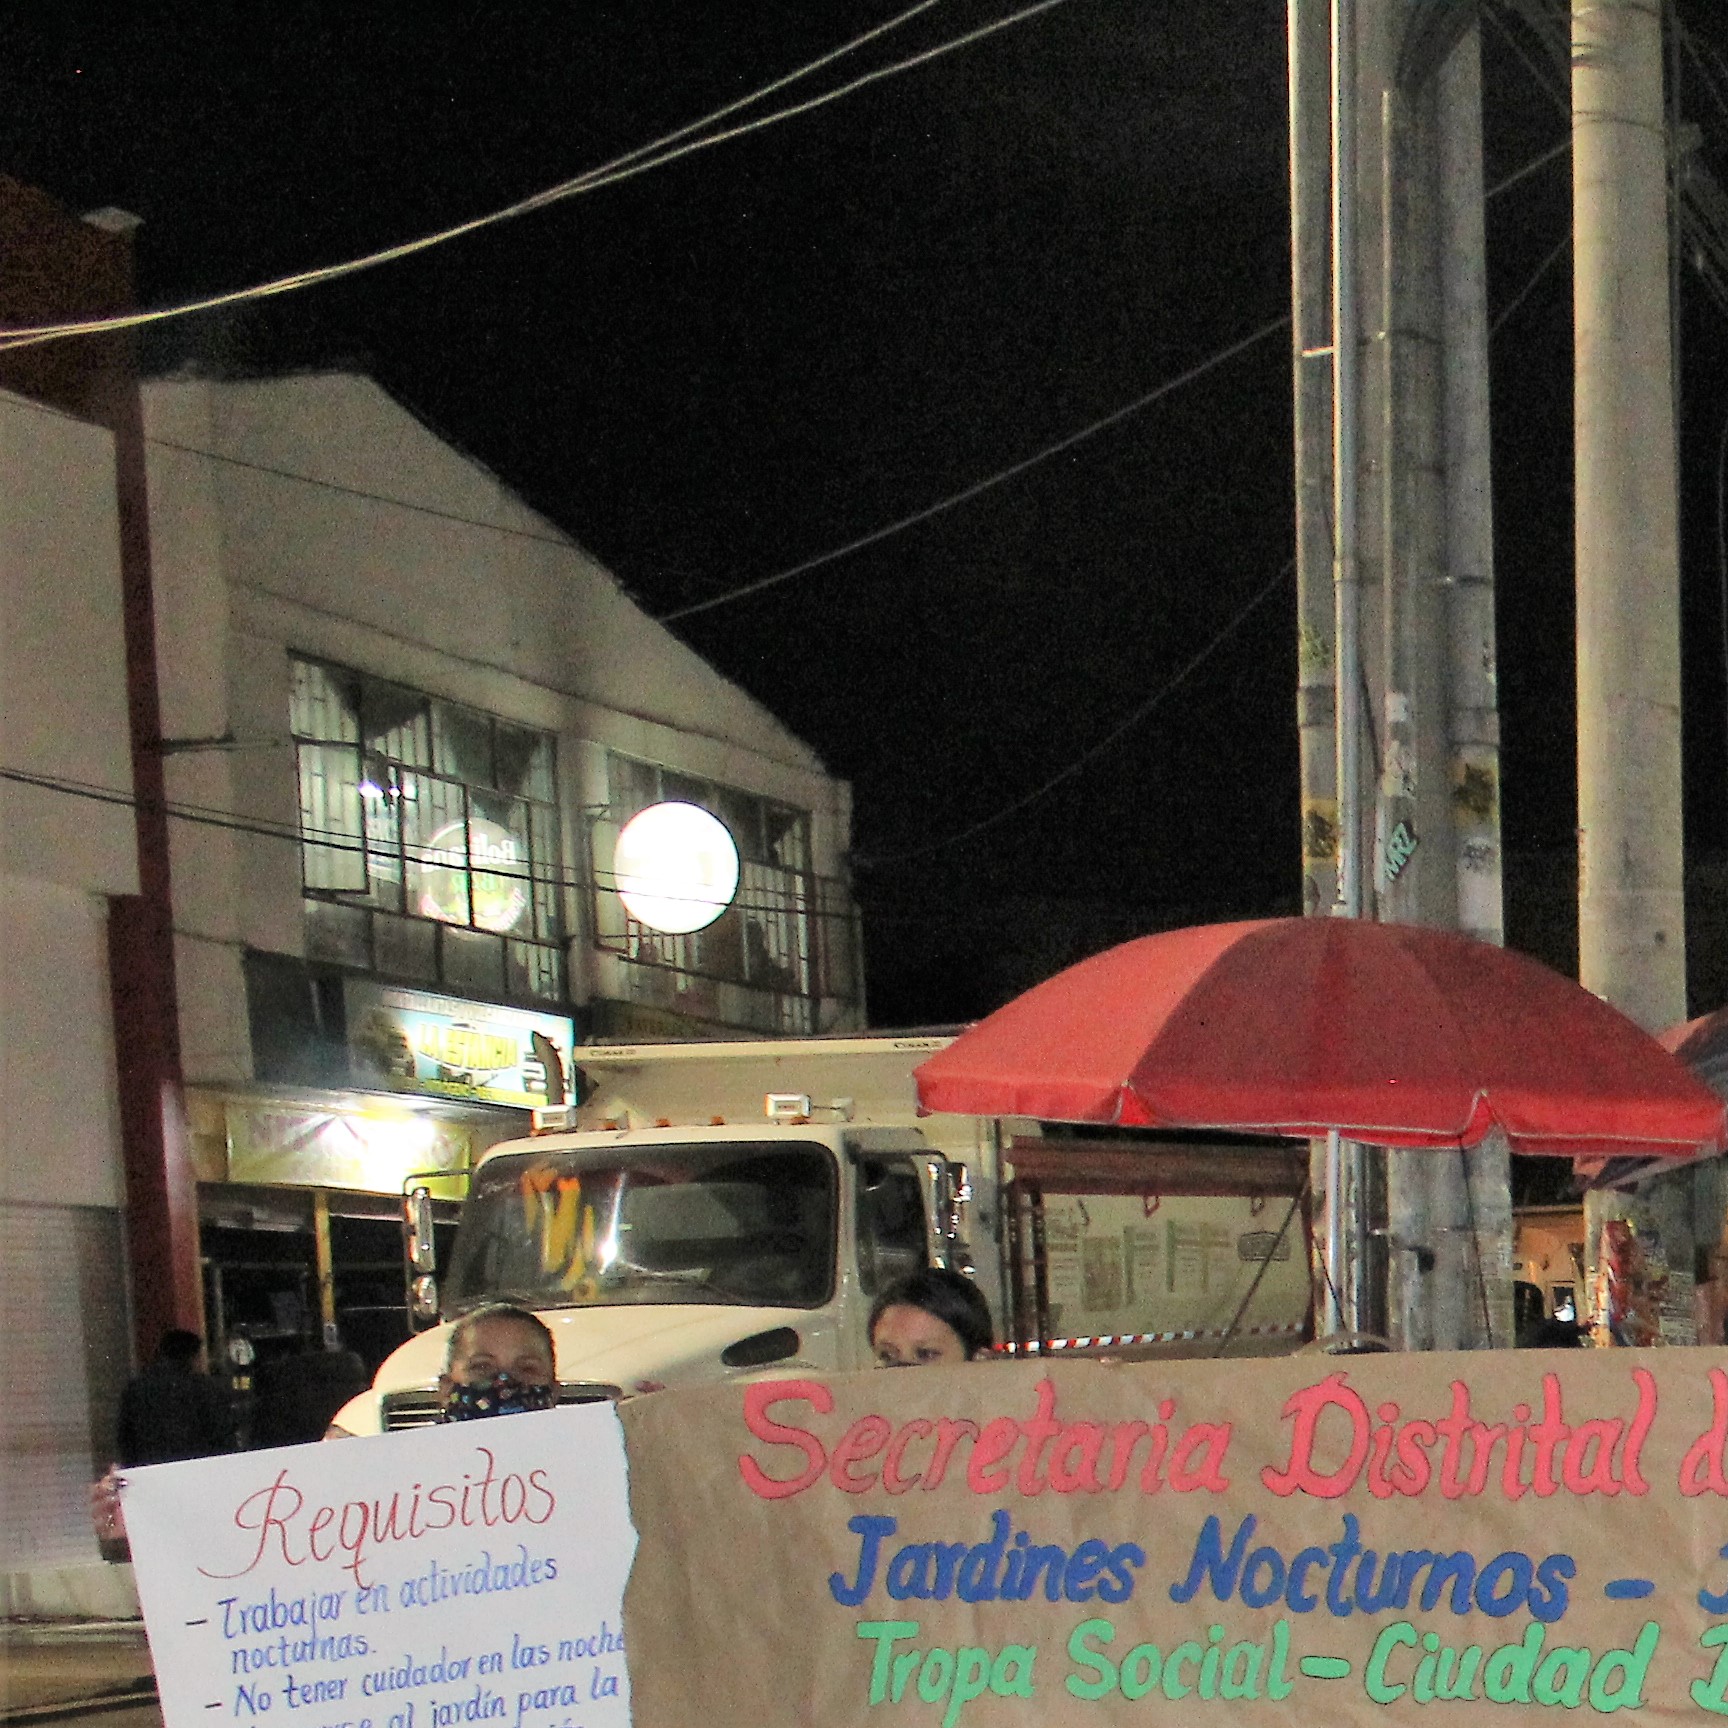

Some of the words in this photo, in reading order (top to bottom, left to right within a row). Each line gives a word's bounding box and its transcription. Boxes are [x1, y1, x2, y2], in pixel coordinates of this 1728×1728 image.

[739, 1377, 1231, 1499] Secretaria
[1261, 1368, 1657, 1499] Distrital
[197, 1447, 556, 1589] Requisitos
[829, 1509, 1146, 1607] Jardines
[1169, 1512, 1576, 1622] Nocturnos
[217, 1590, 345, 1641] Trabajar
[355, 1585, 390, 1613] en
[399, 1545, 557, 1610] actividades
[234, 1684, 272, 1717] No
[281, 1677, 347, 1710] tener
[362, 1653, 471, 1697] cuidador
[478, 1651, 504, 1678] en
[511, 1631, 551, 1669] las
[557, 1622, 626, 1660] noche
[517, 1685, 580, 1724] para
[591, 1668, 620, 1699] la
